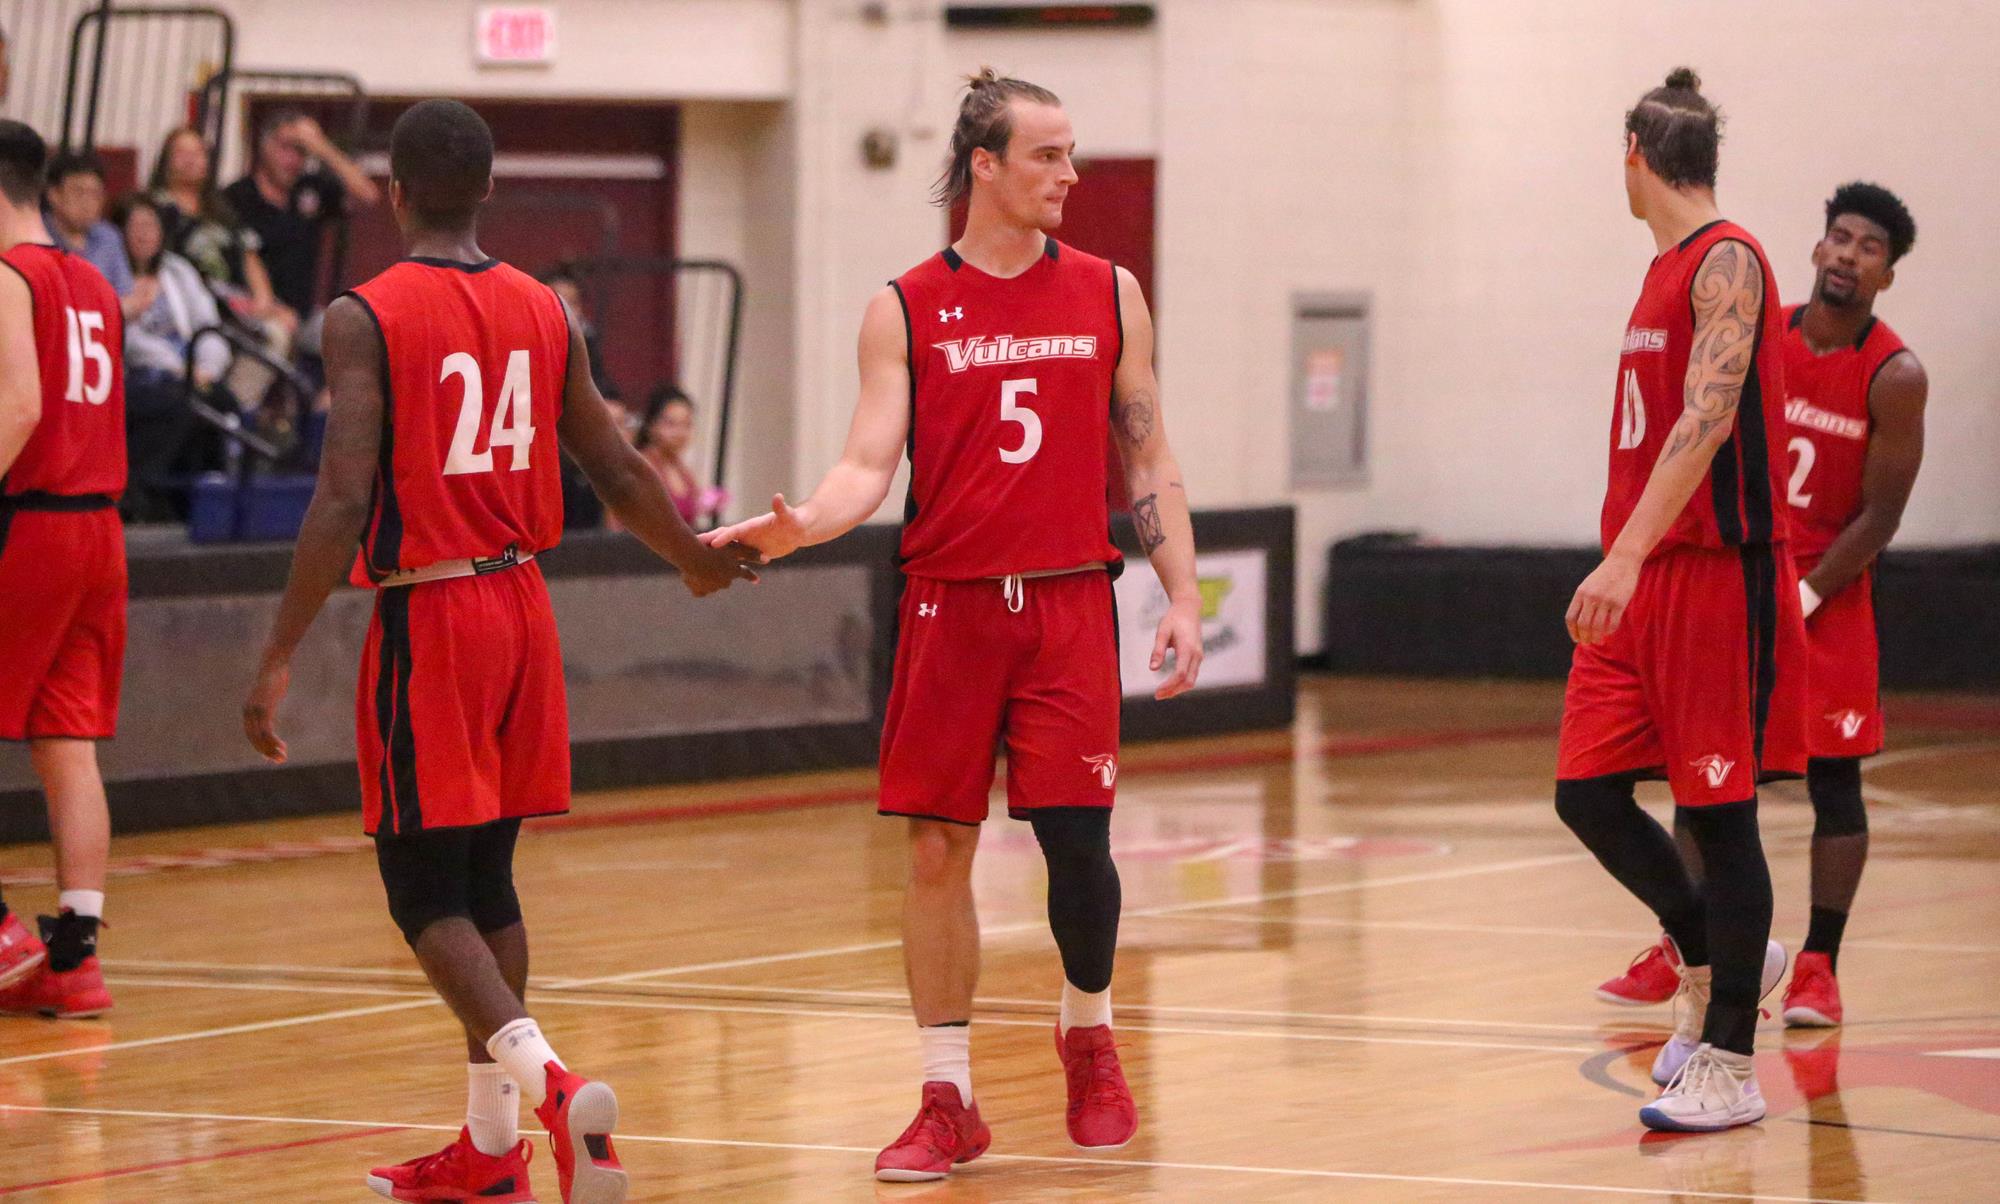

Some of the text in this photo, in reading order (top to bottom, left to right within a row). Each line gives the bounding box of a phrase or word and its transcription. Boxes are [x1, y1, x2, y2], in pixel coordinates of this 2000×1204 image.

[64, 305, 113, 405] 15
[931, 334, 1097, 374] Vulcans
[440, 349, 536, 476] 24
[998, 378, 1043, 464] 5
[1617, 367, 1647, 450] 10
[1787, 437, 1816, 508] 2
